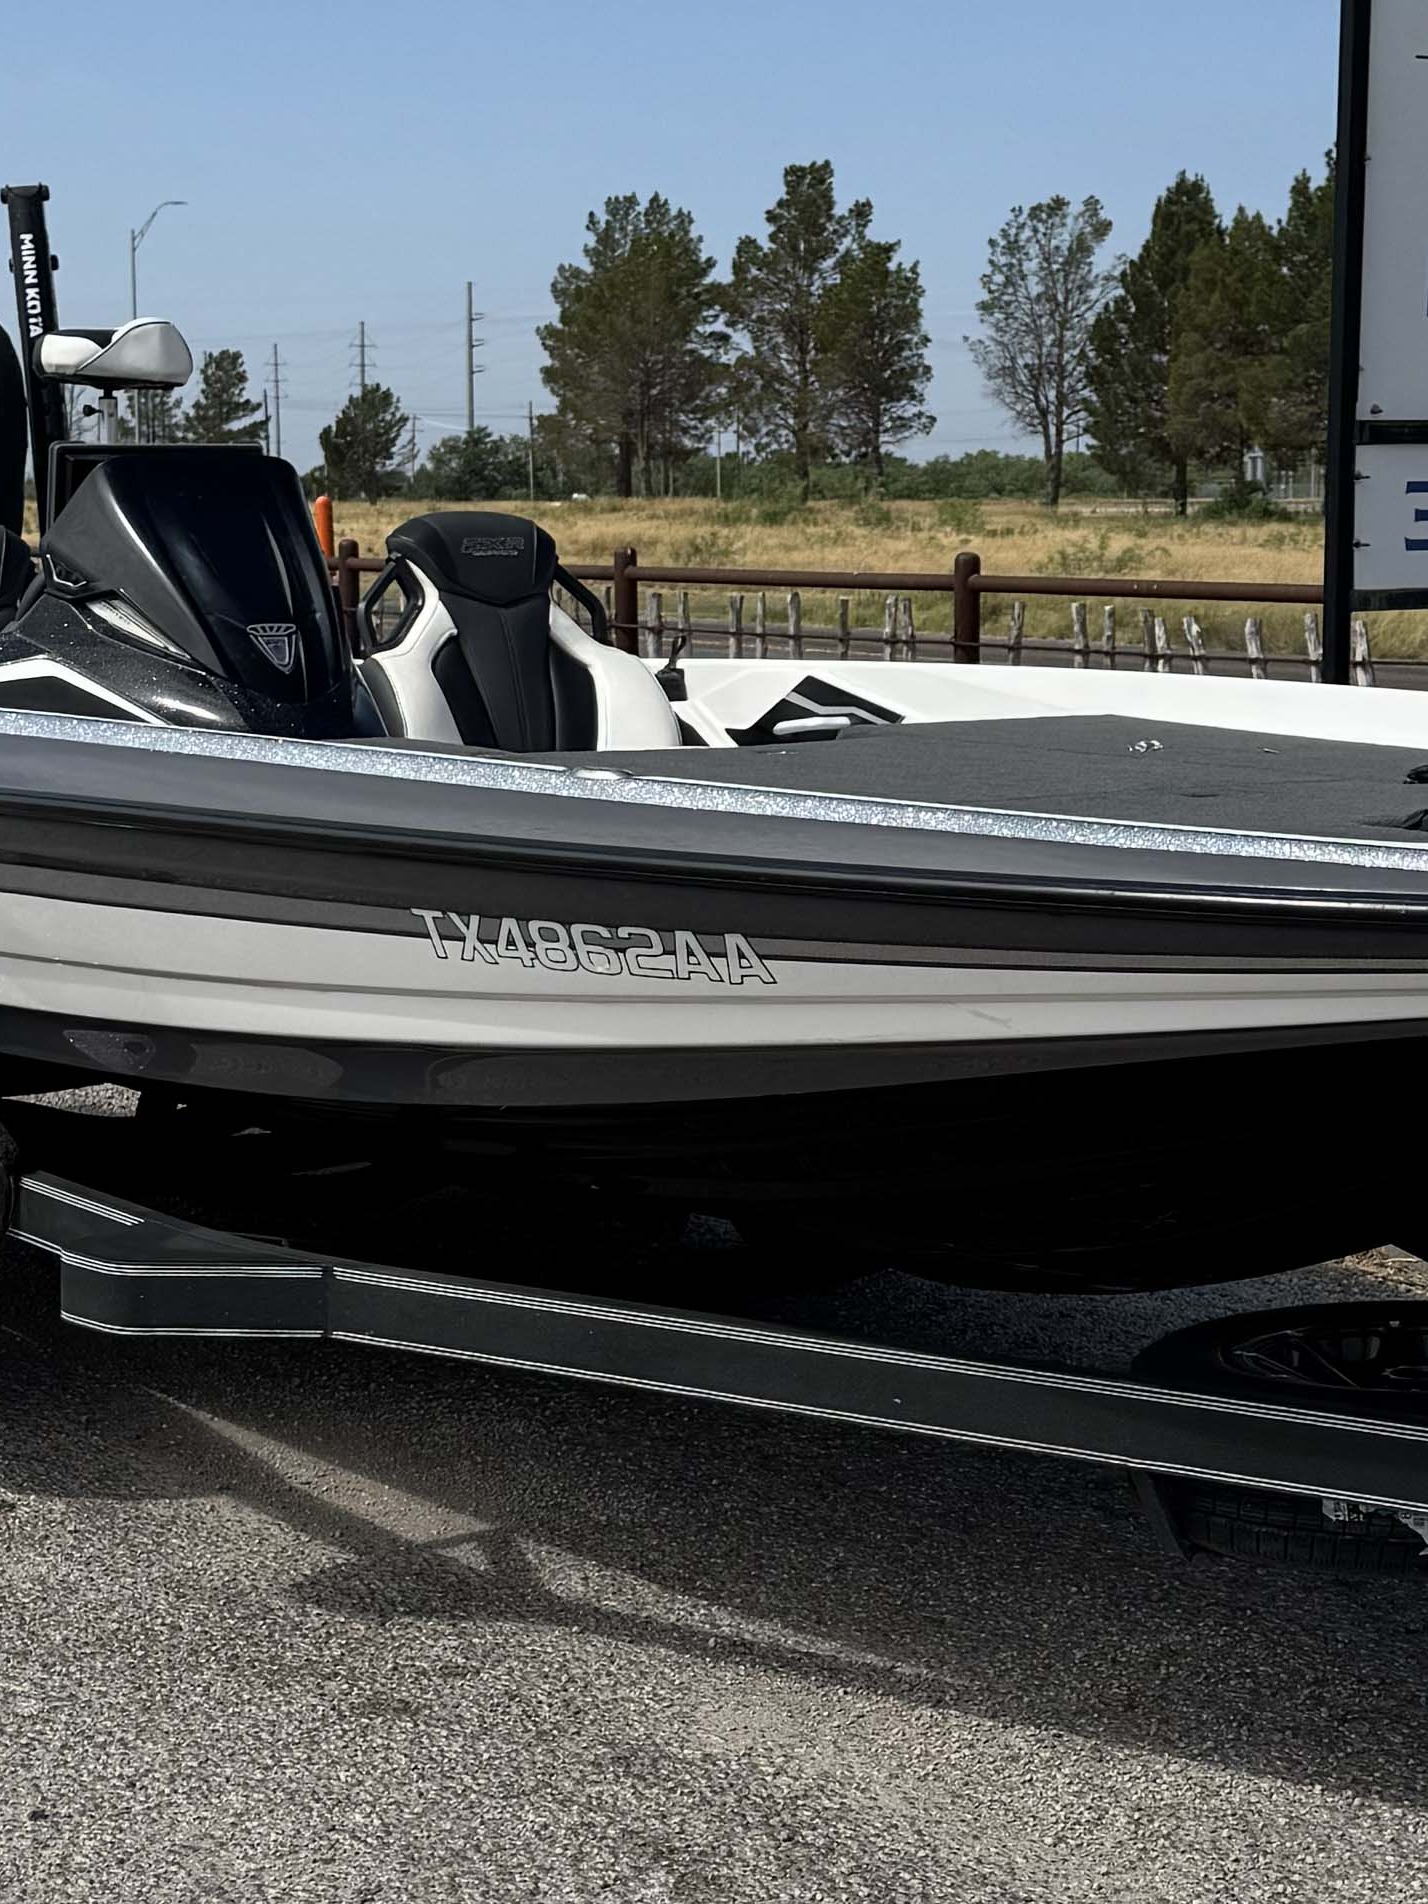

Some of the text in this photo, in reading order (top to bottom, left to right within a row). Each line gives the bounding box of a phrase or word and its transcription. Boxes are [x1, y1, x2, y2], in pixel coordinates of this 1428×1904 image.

[19, 233, 44, 338] MINN KOTA
[410, 906, 778, 985] TX4862AA
